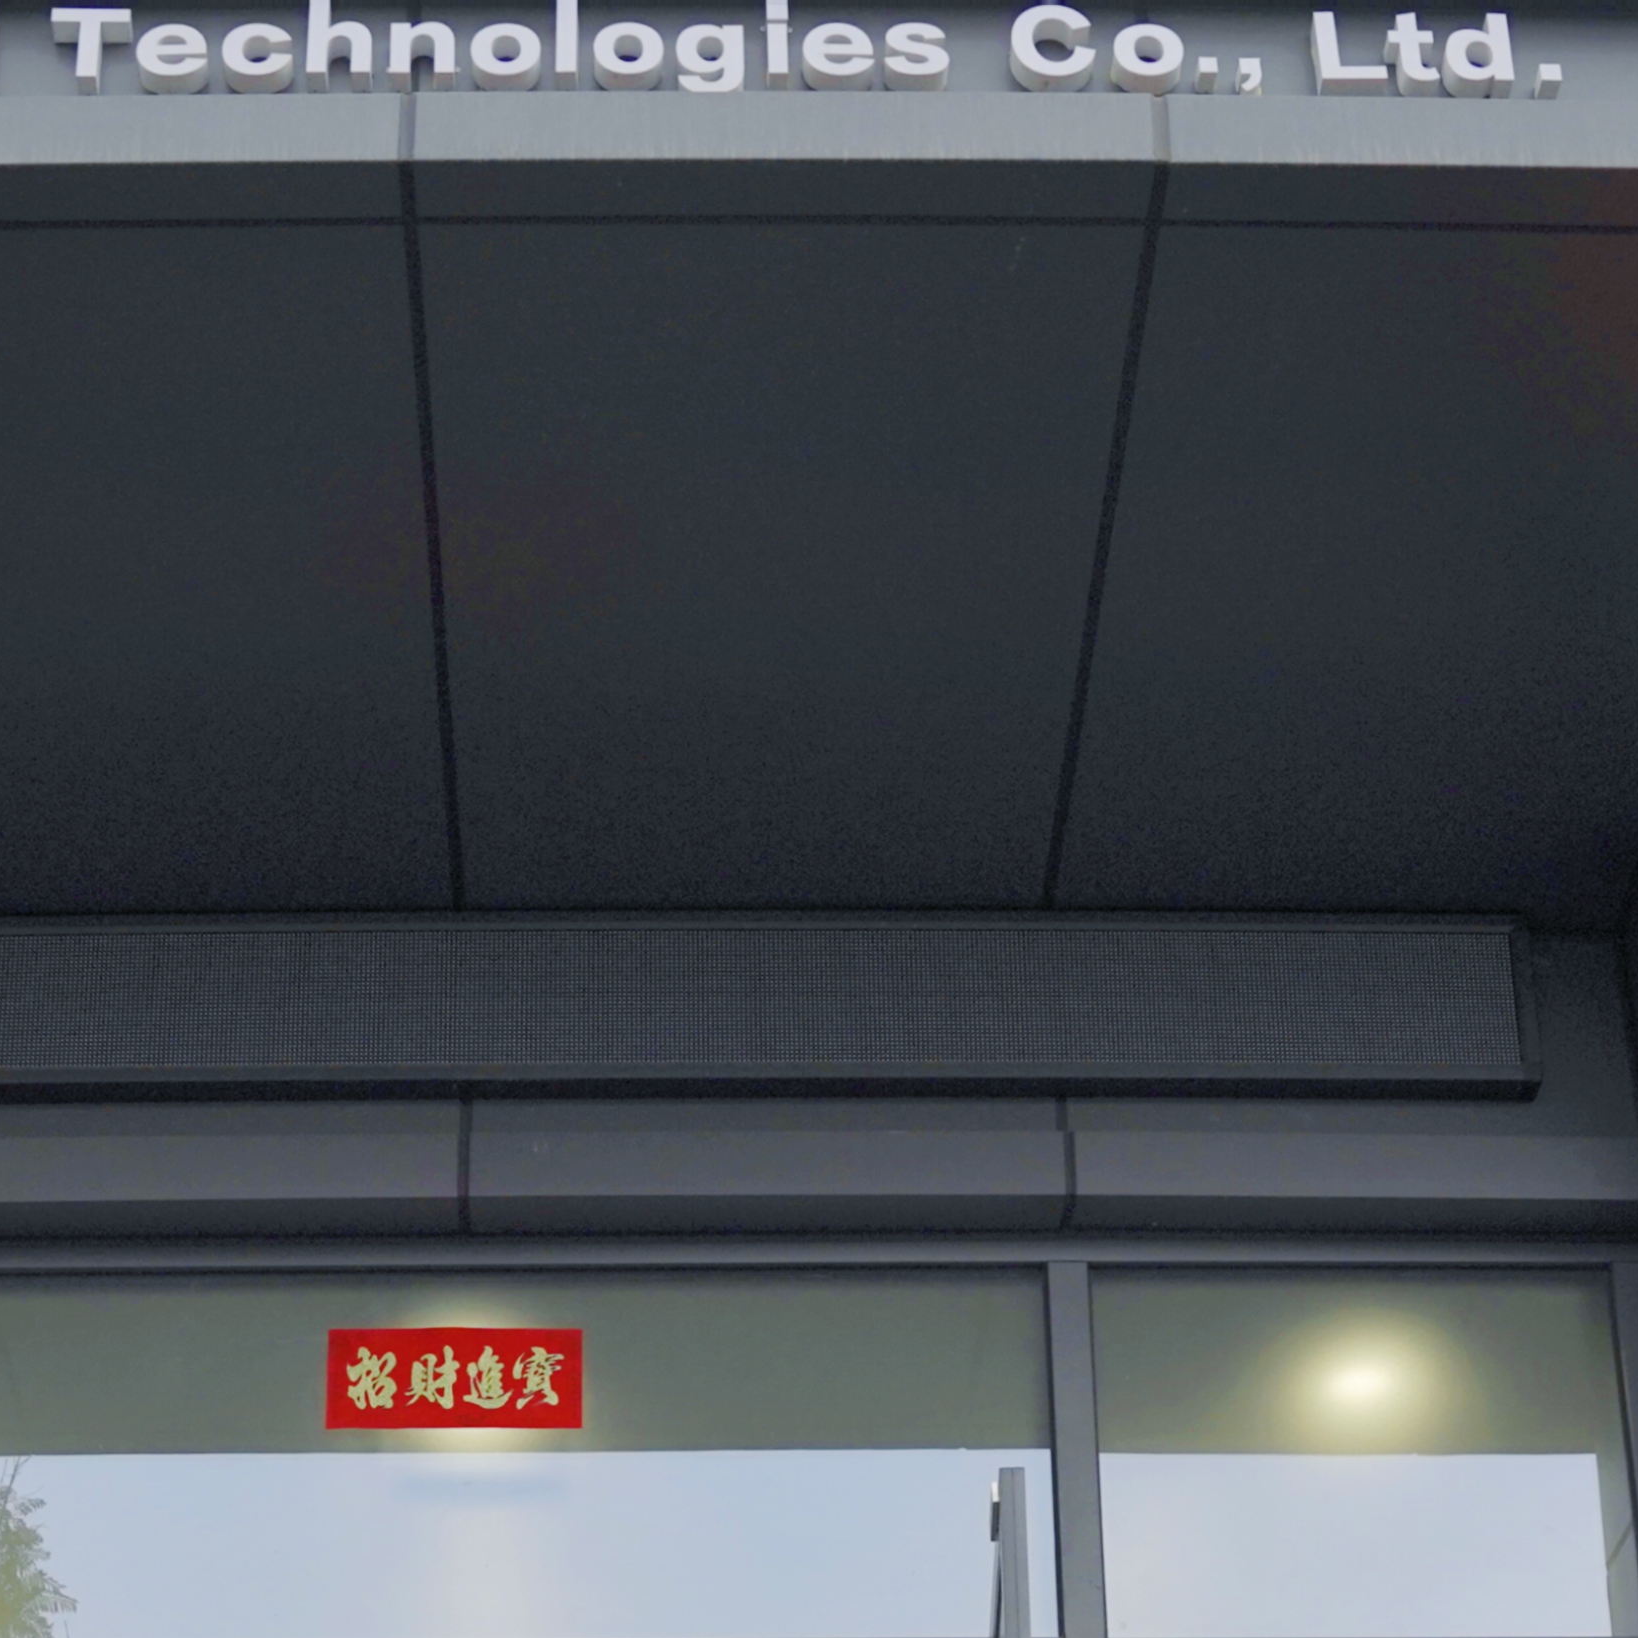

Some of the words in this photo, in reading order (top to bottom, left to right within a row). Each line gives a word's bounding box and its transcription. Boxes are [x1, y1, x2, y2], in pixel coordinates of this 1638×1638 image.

[51, 0, 950, 94] Technologies
[1008, 4, 1262, 95] Co.,
[1311, 11, 1562, 99] Ltd.
